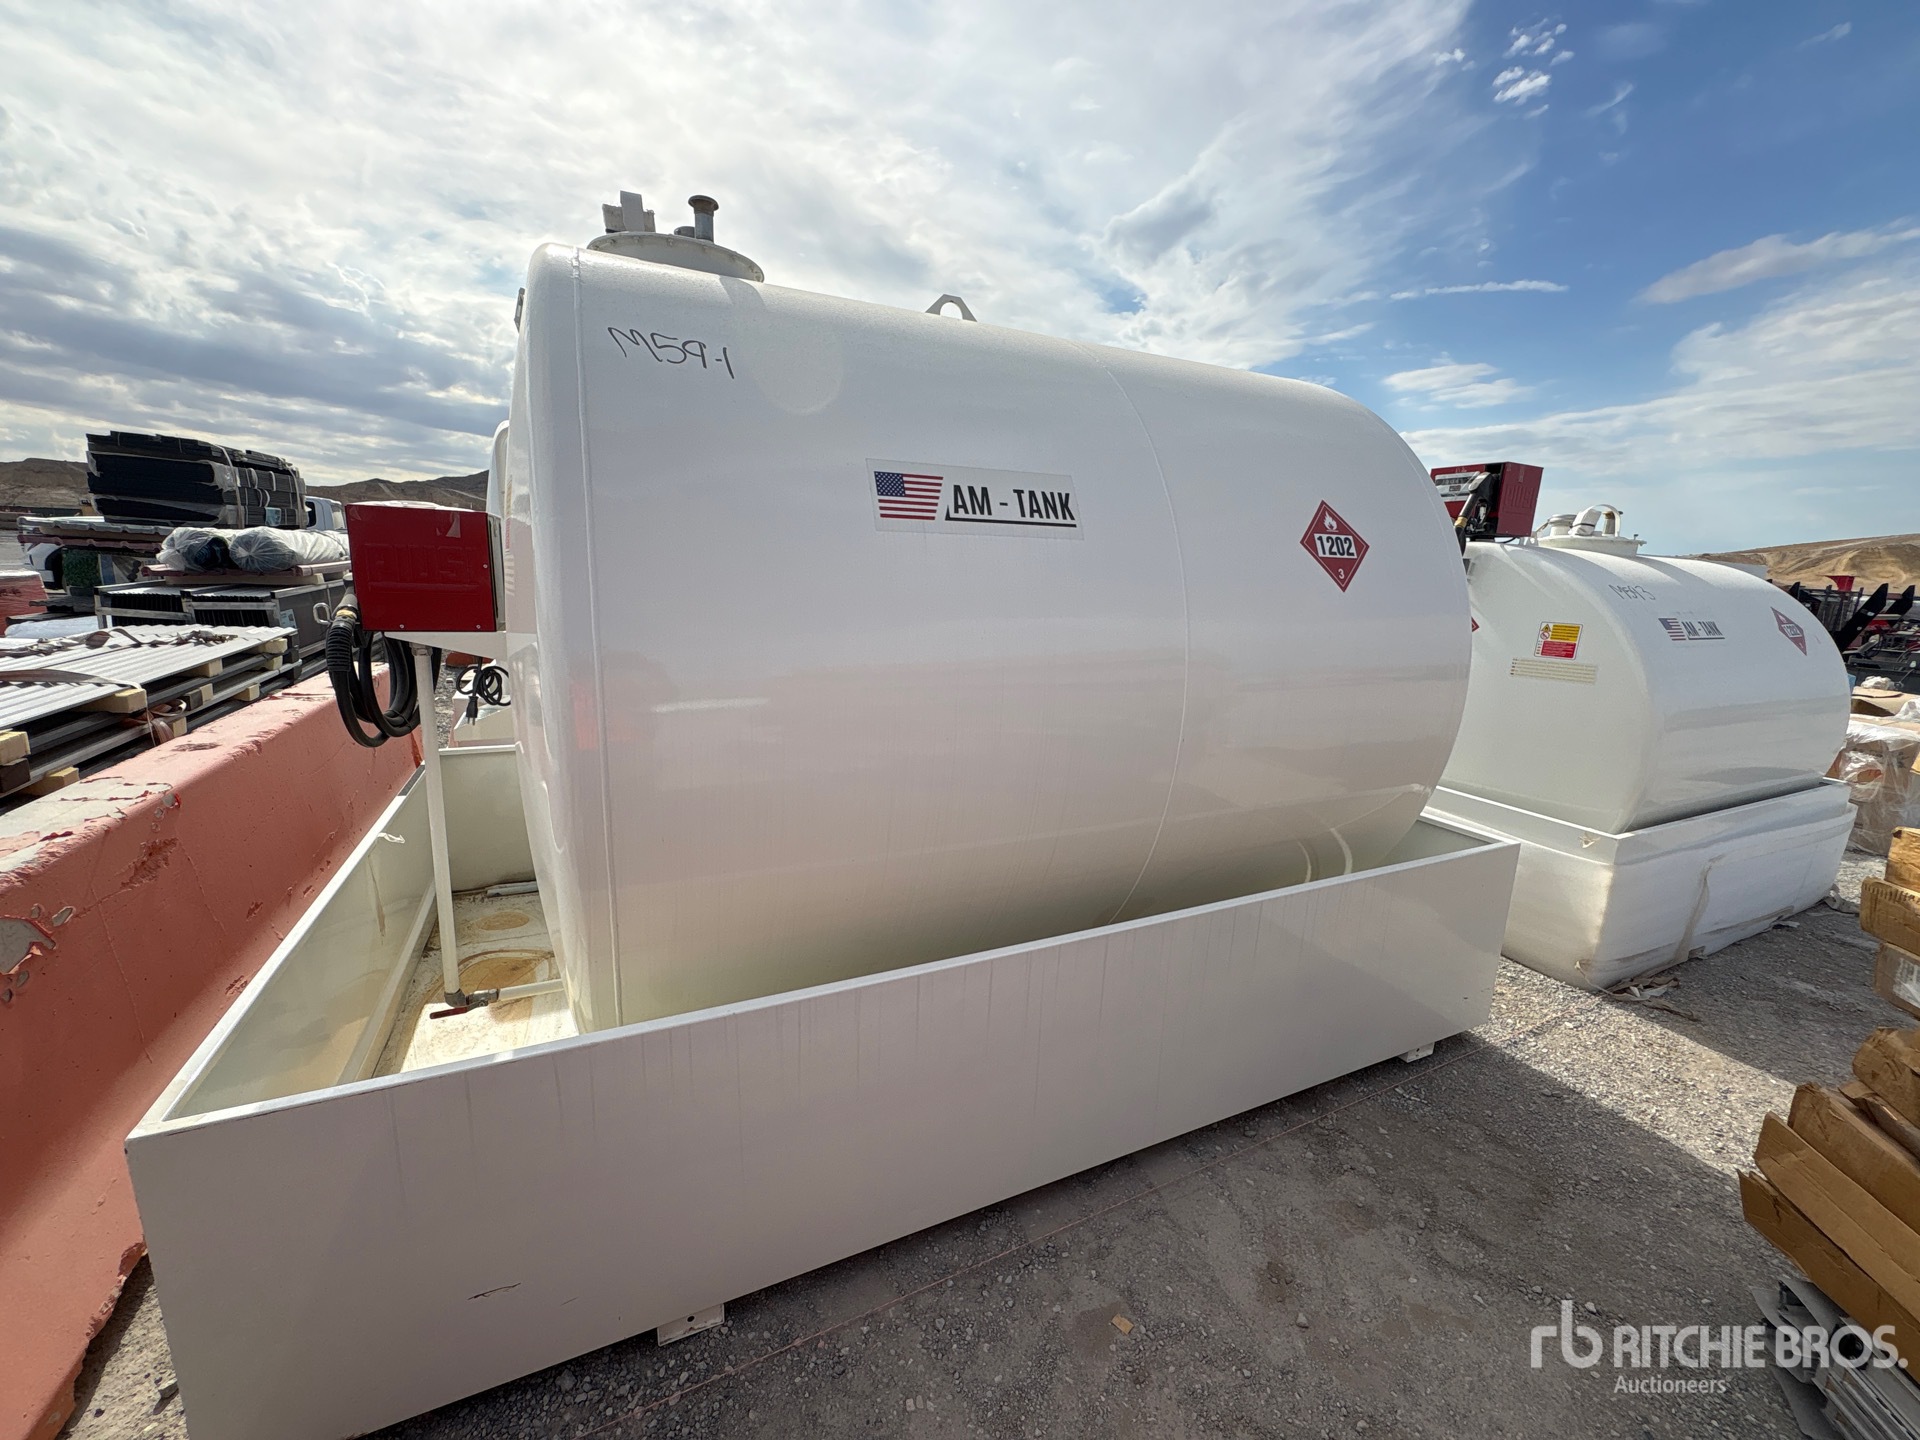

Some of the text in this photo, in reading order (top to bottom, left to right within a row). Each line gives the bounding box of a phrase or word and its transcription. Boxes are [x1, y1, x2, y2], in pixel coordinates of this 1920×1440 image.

[607, 327, 734, 379] M59-1
[953, 484, 993, 516] AM
[1012, 489, 1076, 520] TANK
[1317, 535, 1355, 557] 1202
[1338, 568, 1345, 579] 3
